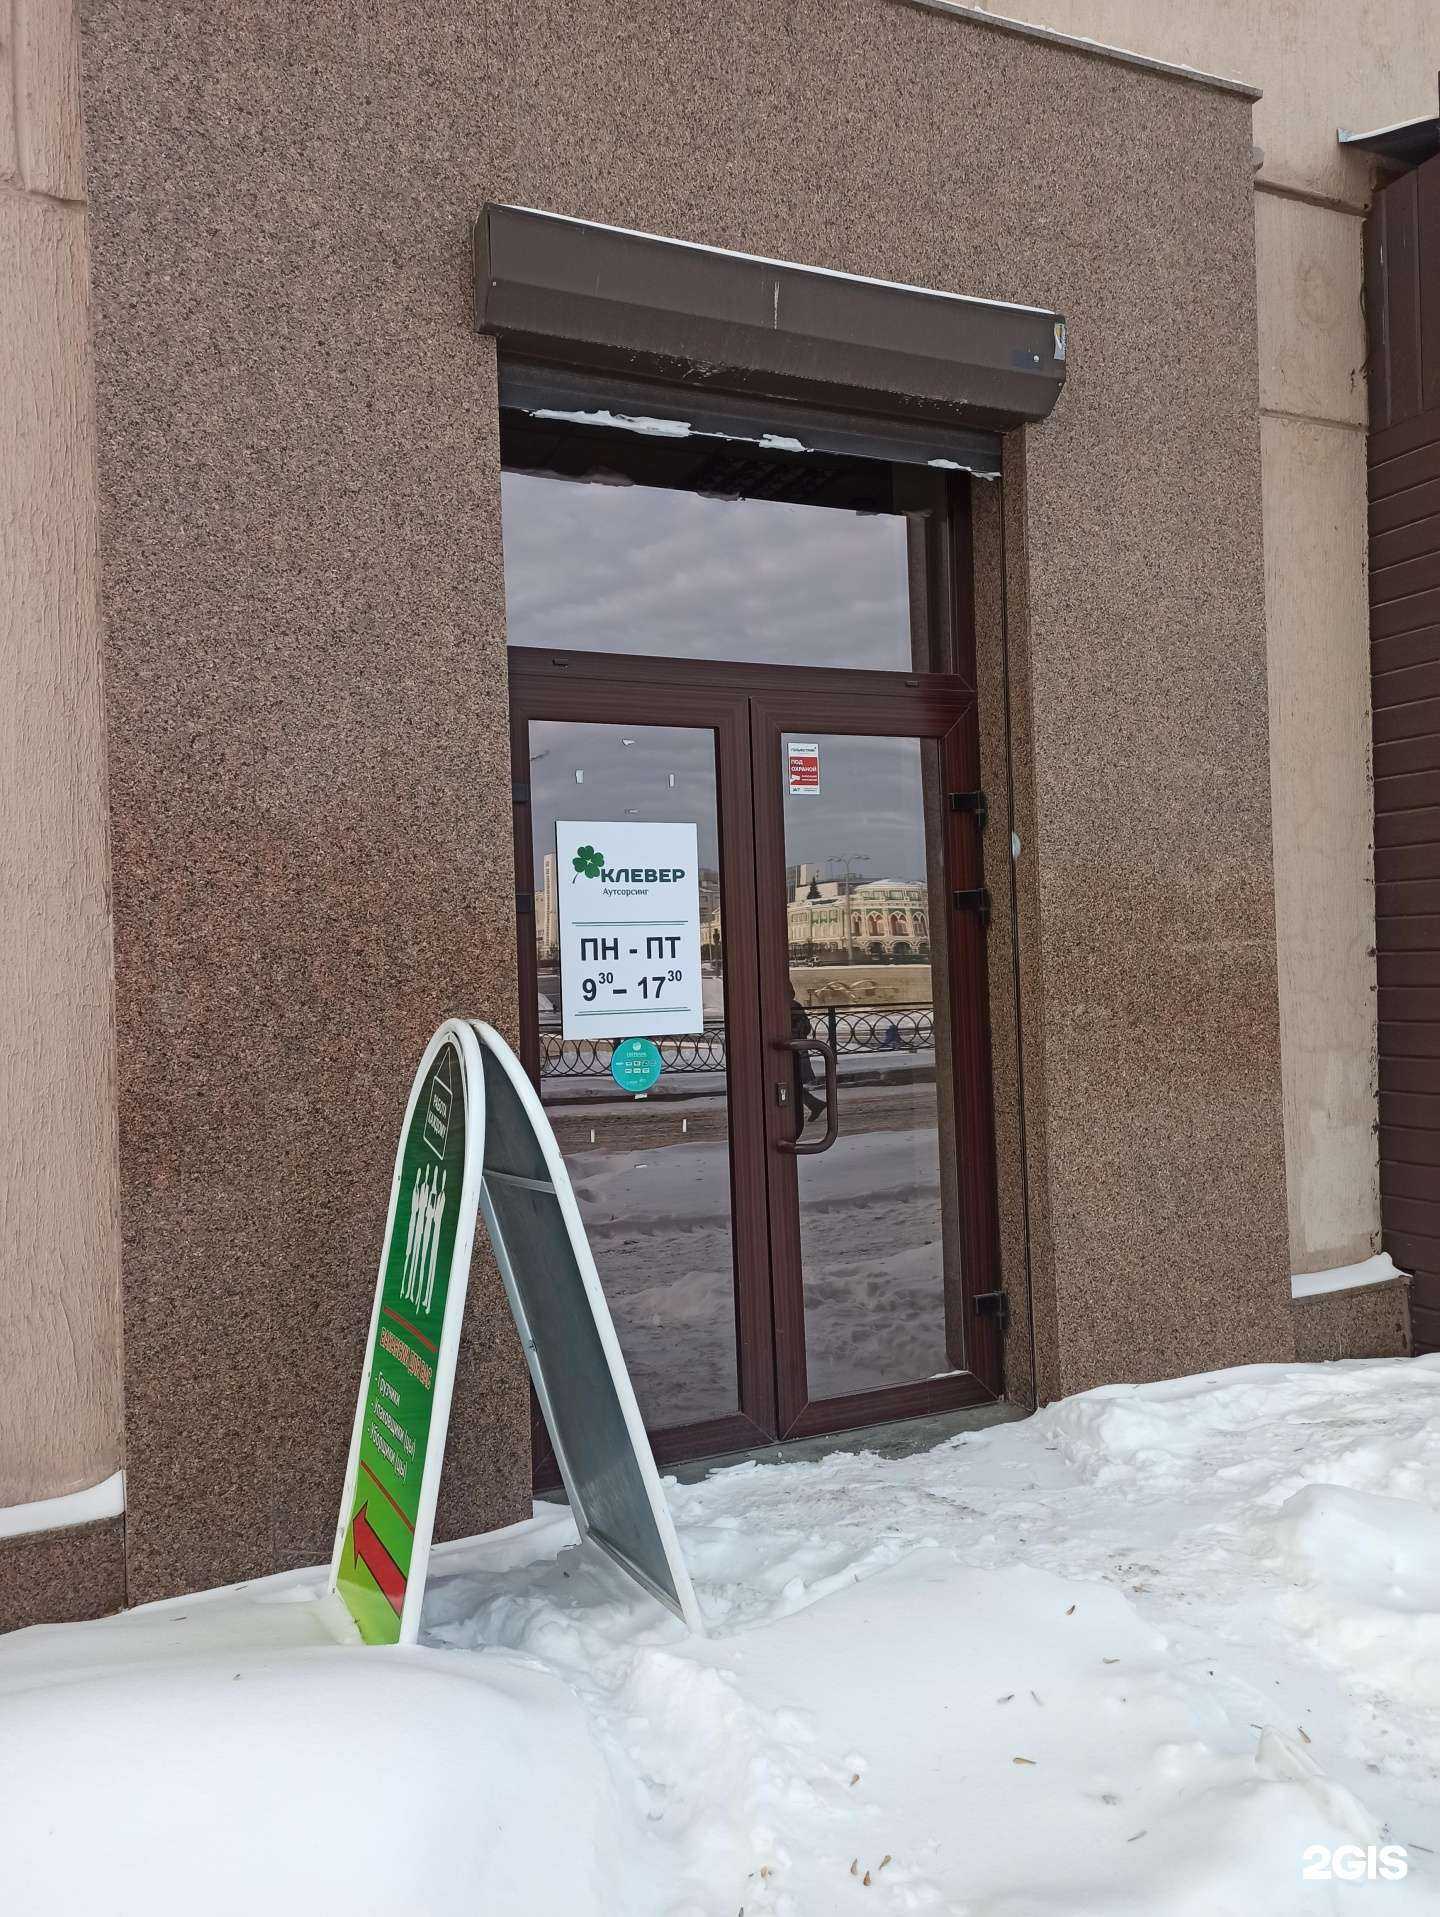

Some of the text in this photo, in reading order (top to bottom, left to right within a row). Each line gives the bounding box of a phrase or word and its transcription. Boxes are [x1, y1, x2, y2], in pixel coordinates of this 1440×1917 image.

[601, 868, 686, 883] КЛЕВЕР
[602, 888, 649, 896] Аутсорсинг
[580, 937, 619, 961] ПН
[646, 936, 681, 959] ПТ
